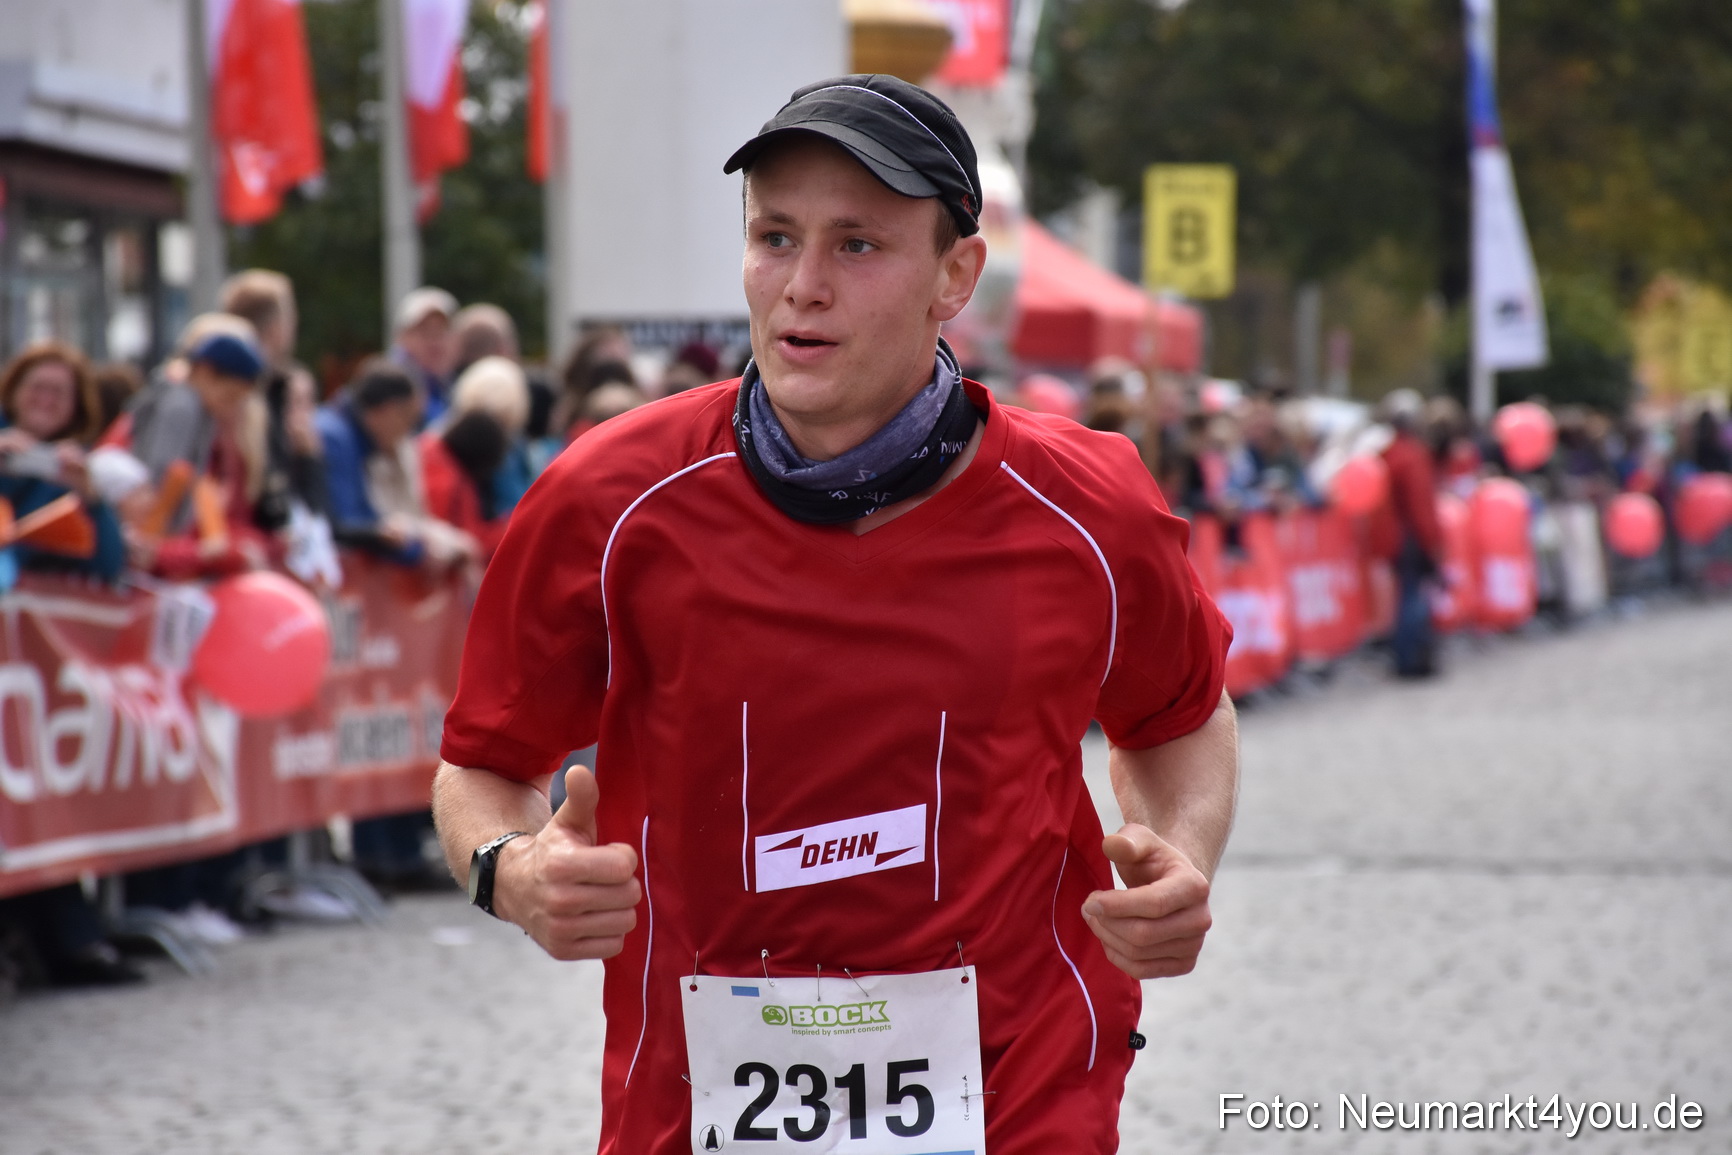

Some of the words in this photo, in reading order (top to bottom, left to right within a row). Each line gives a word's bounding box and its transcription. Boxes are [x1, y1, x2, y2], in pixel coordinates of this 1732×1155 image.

[800, 831, 879, 869] DEHN
[789, 1001, 890, 1027] BOCK
[791, 1027, 820, 1036] inspired
[822, 1028, 831, 1037] by
[833, 1027, 856, 1035] smart
[857, 1024, 892, 1034] concepts
[733, 1058, 935, 1142] 2315
